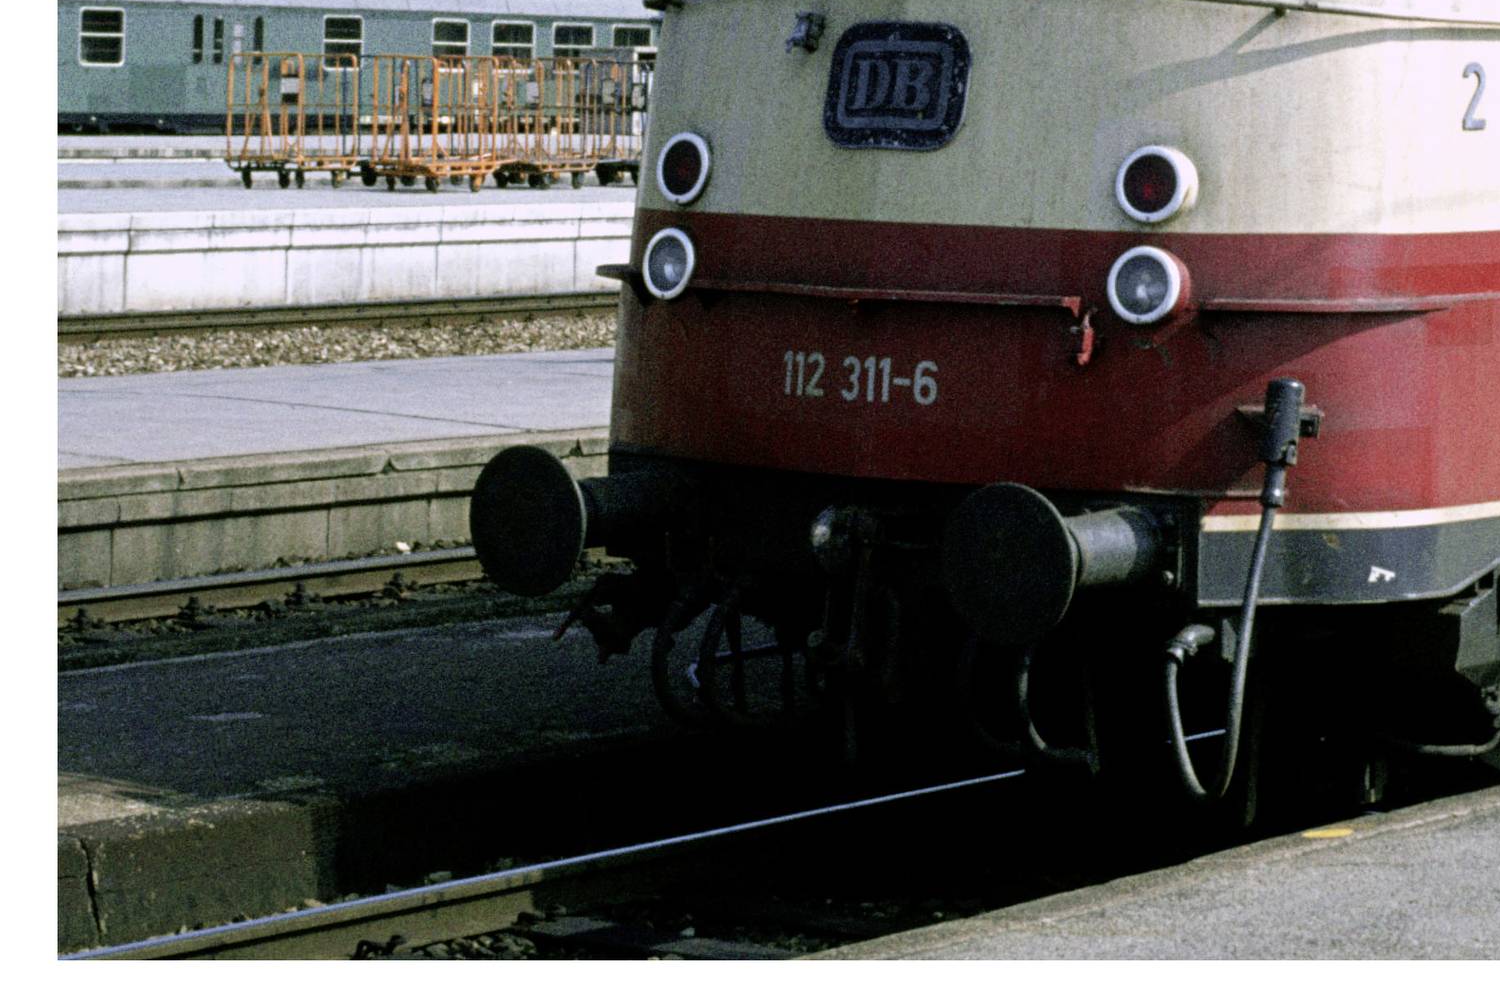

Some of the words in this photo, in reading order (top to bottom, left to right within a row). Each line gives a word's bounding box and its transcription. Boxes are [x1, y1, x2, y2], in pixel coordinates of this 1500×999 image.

[1462, 62, 1487, 130] 2
[783, 350, 826, 397] 112
[841, 356, 939, 405] 311-6
